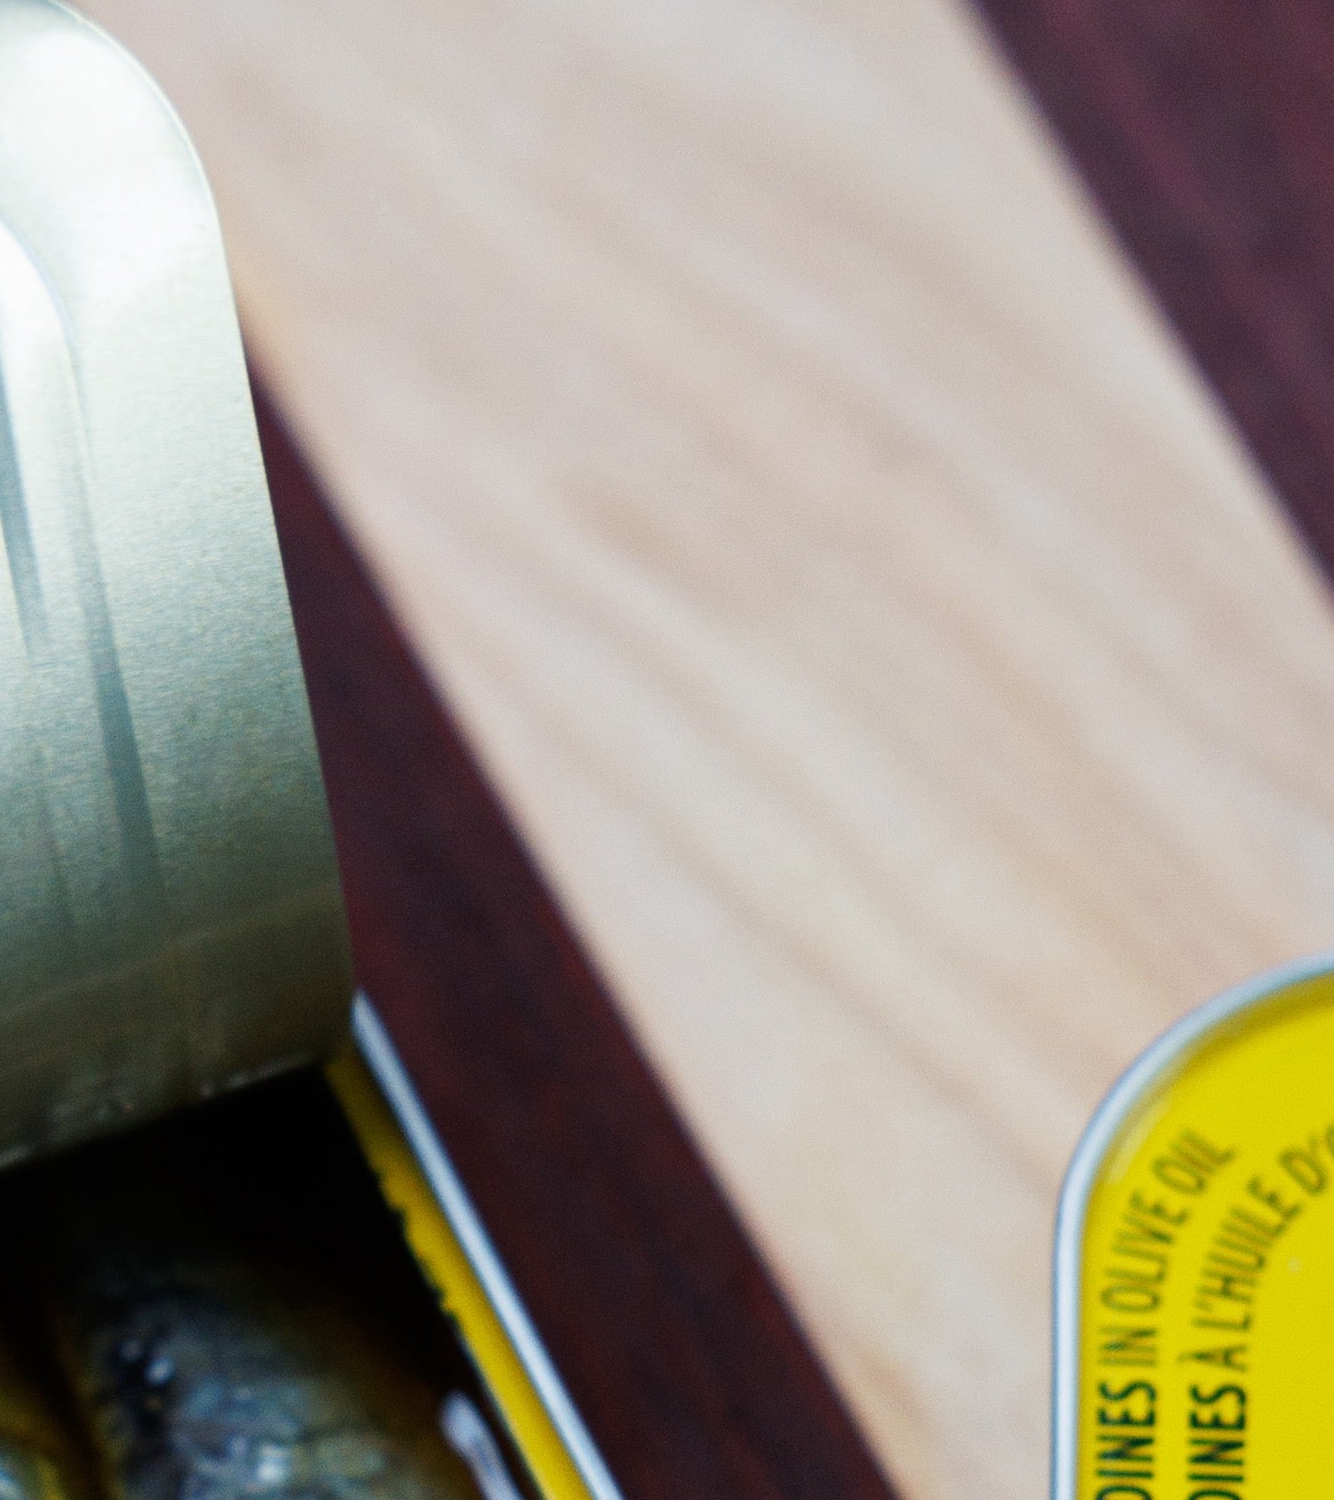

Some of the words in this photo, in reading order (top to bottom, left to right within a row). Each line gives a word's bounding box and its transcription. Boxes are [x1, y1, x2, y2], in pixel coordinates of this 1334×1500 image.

[1152, 1128, 1236, 1195] OIL
[1099, 1188, 1190, 1313] OLIVE
[1096, 1325, 1158, 1367] IN
